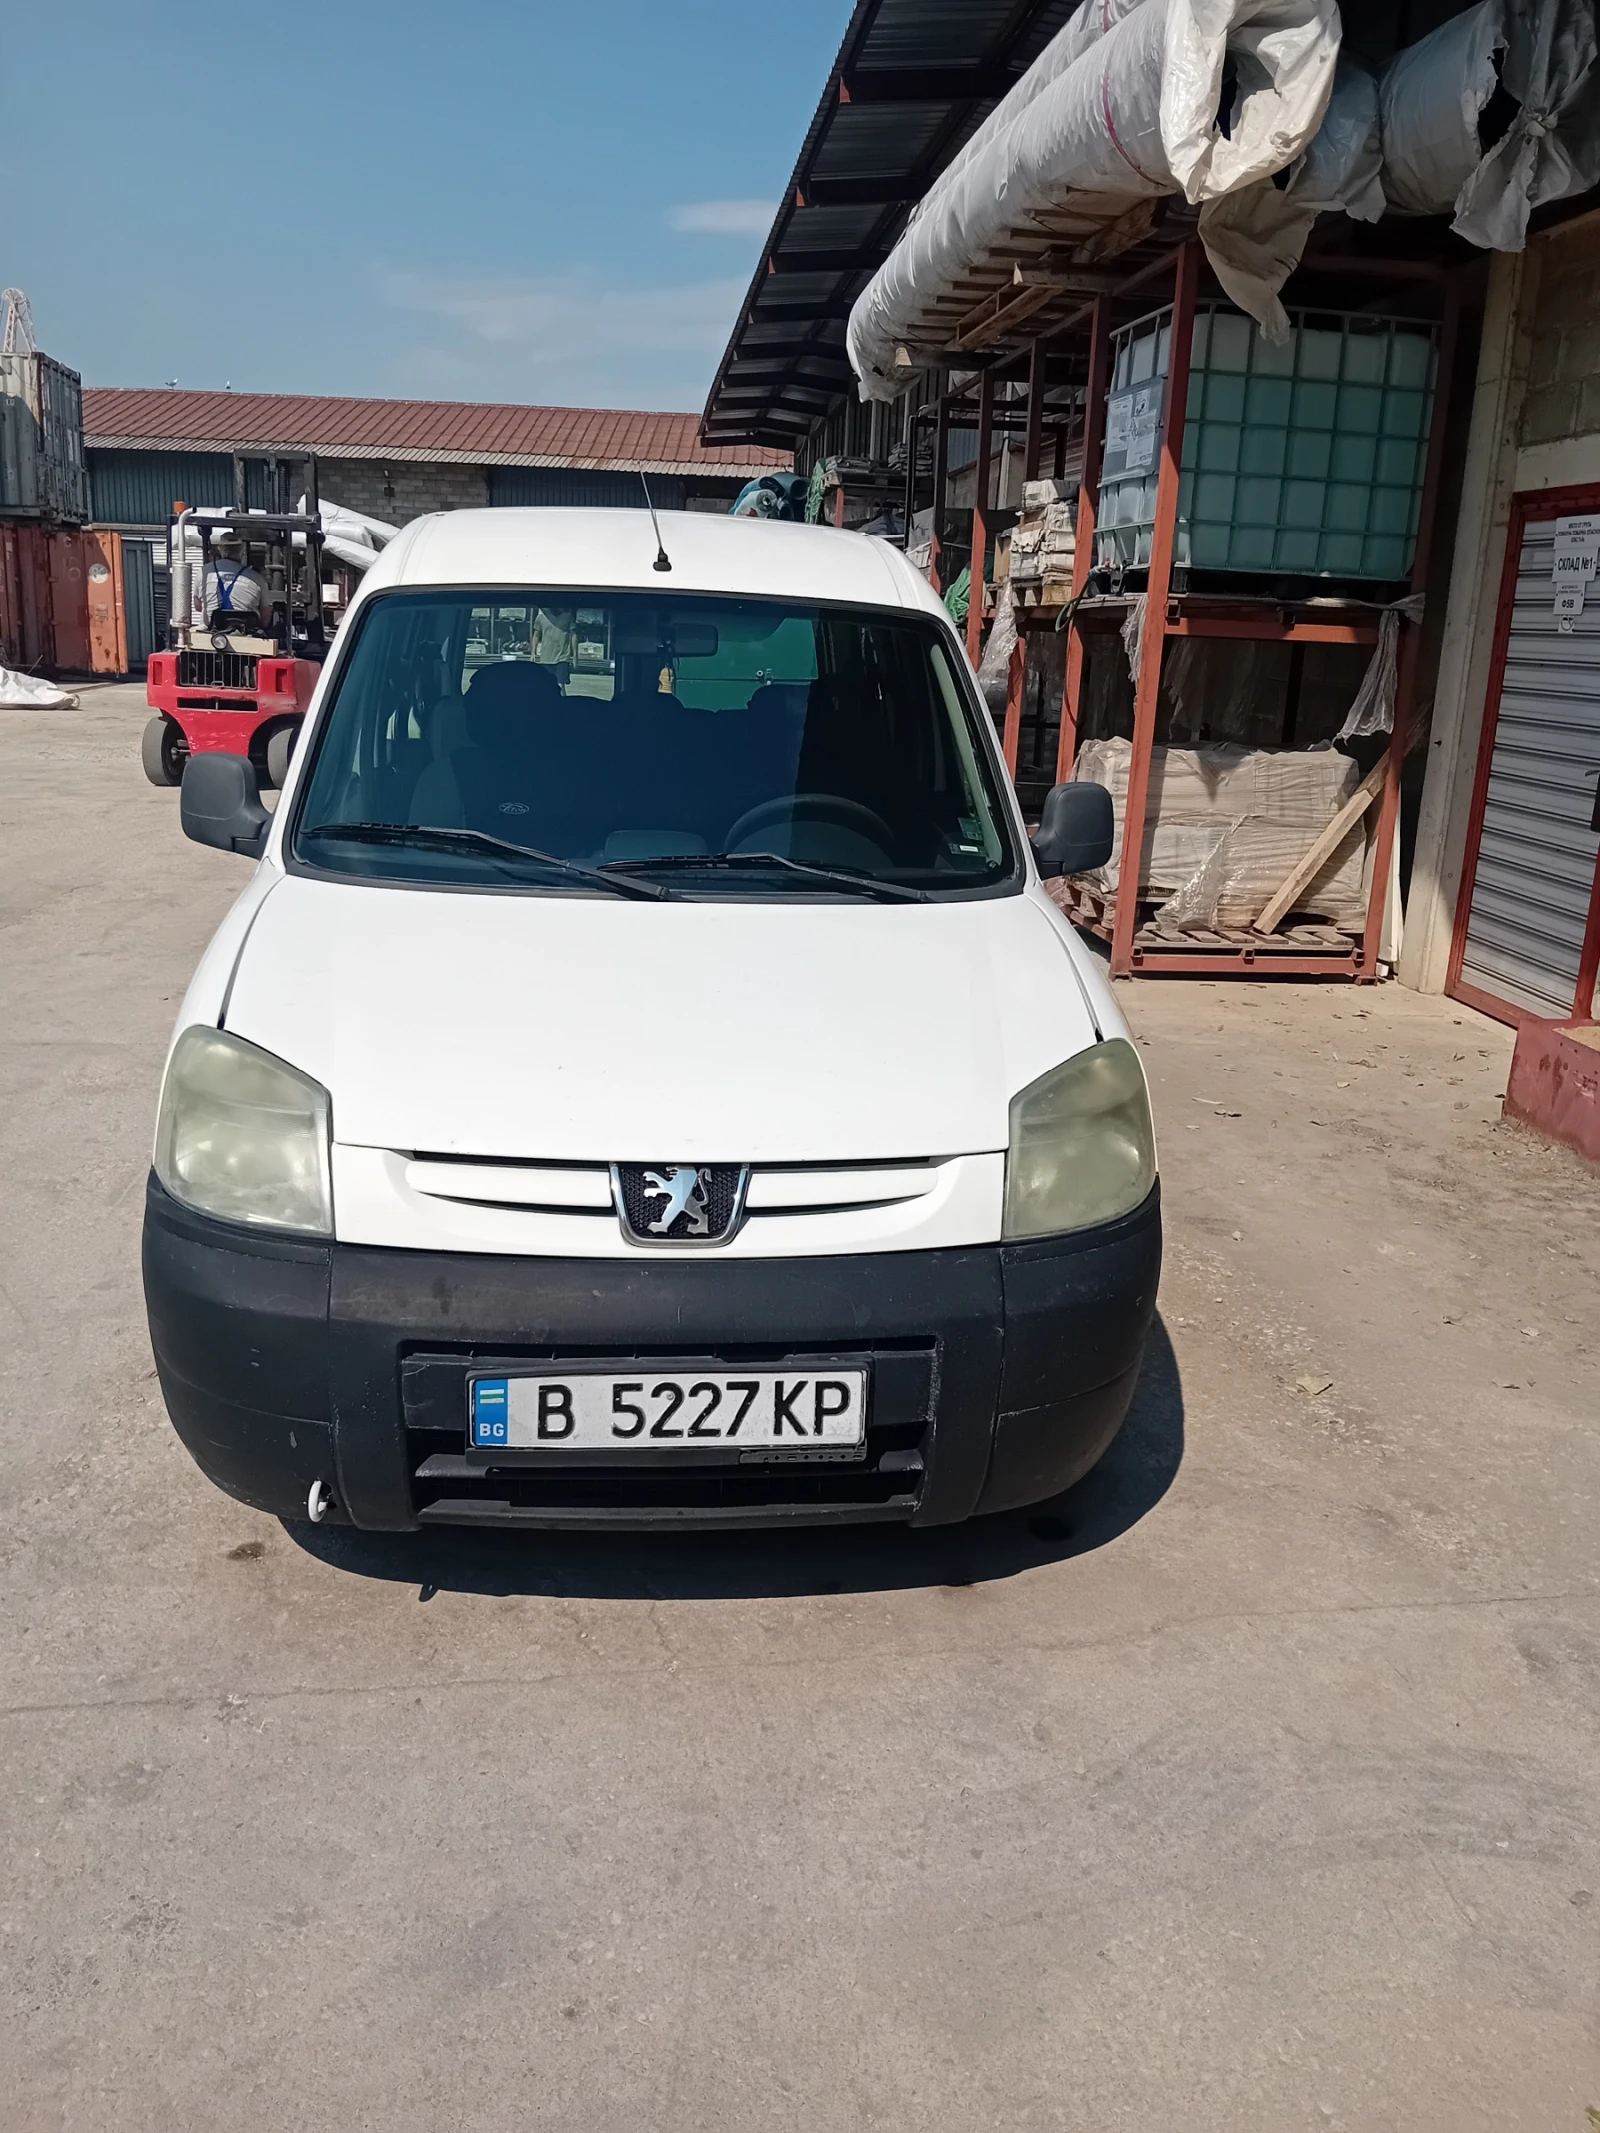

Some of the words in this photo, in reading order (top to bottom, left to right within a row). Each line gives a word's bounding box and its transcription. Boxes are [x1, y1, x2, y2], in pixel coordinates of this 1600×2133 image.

[1558, 556, 1580, 572] СКЛАД
[1580, 556, 1593, 570] №1
[479, 1423, 504, 1437] BG
